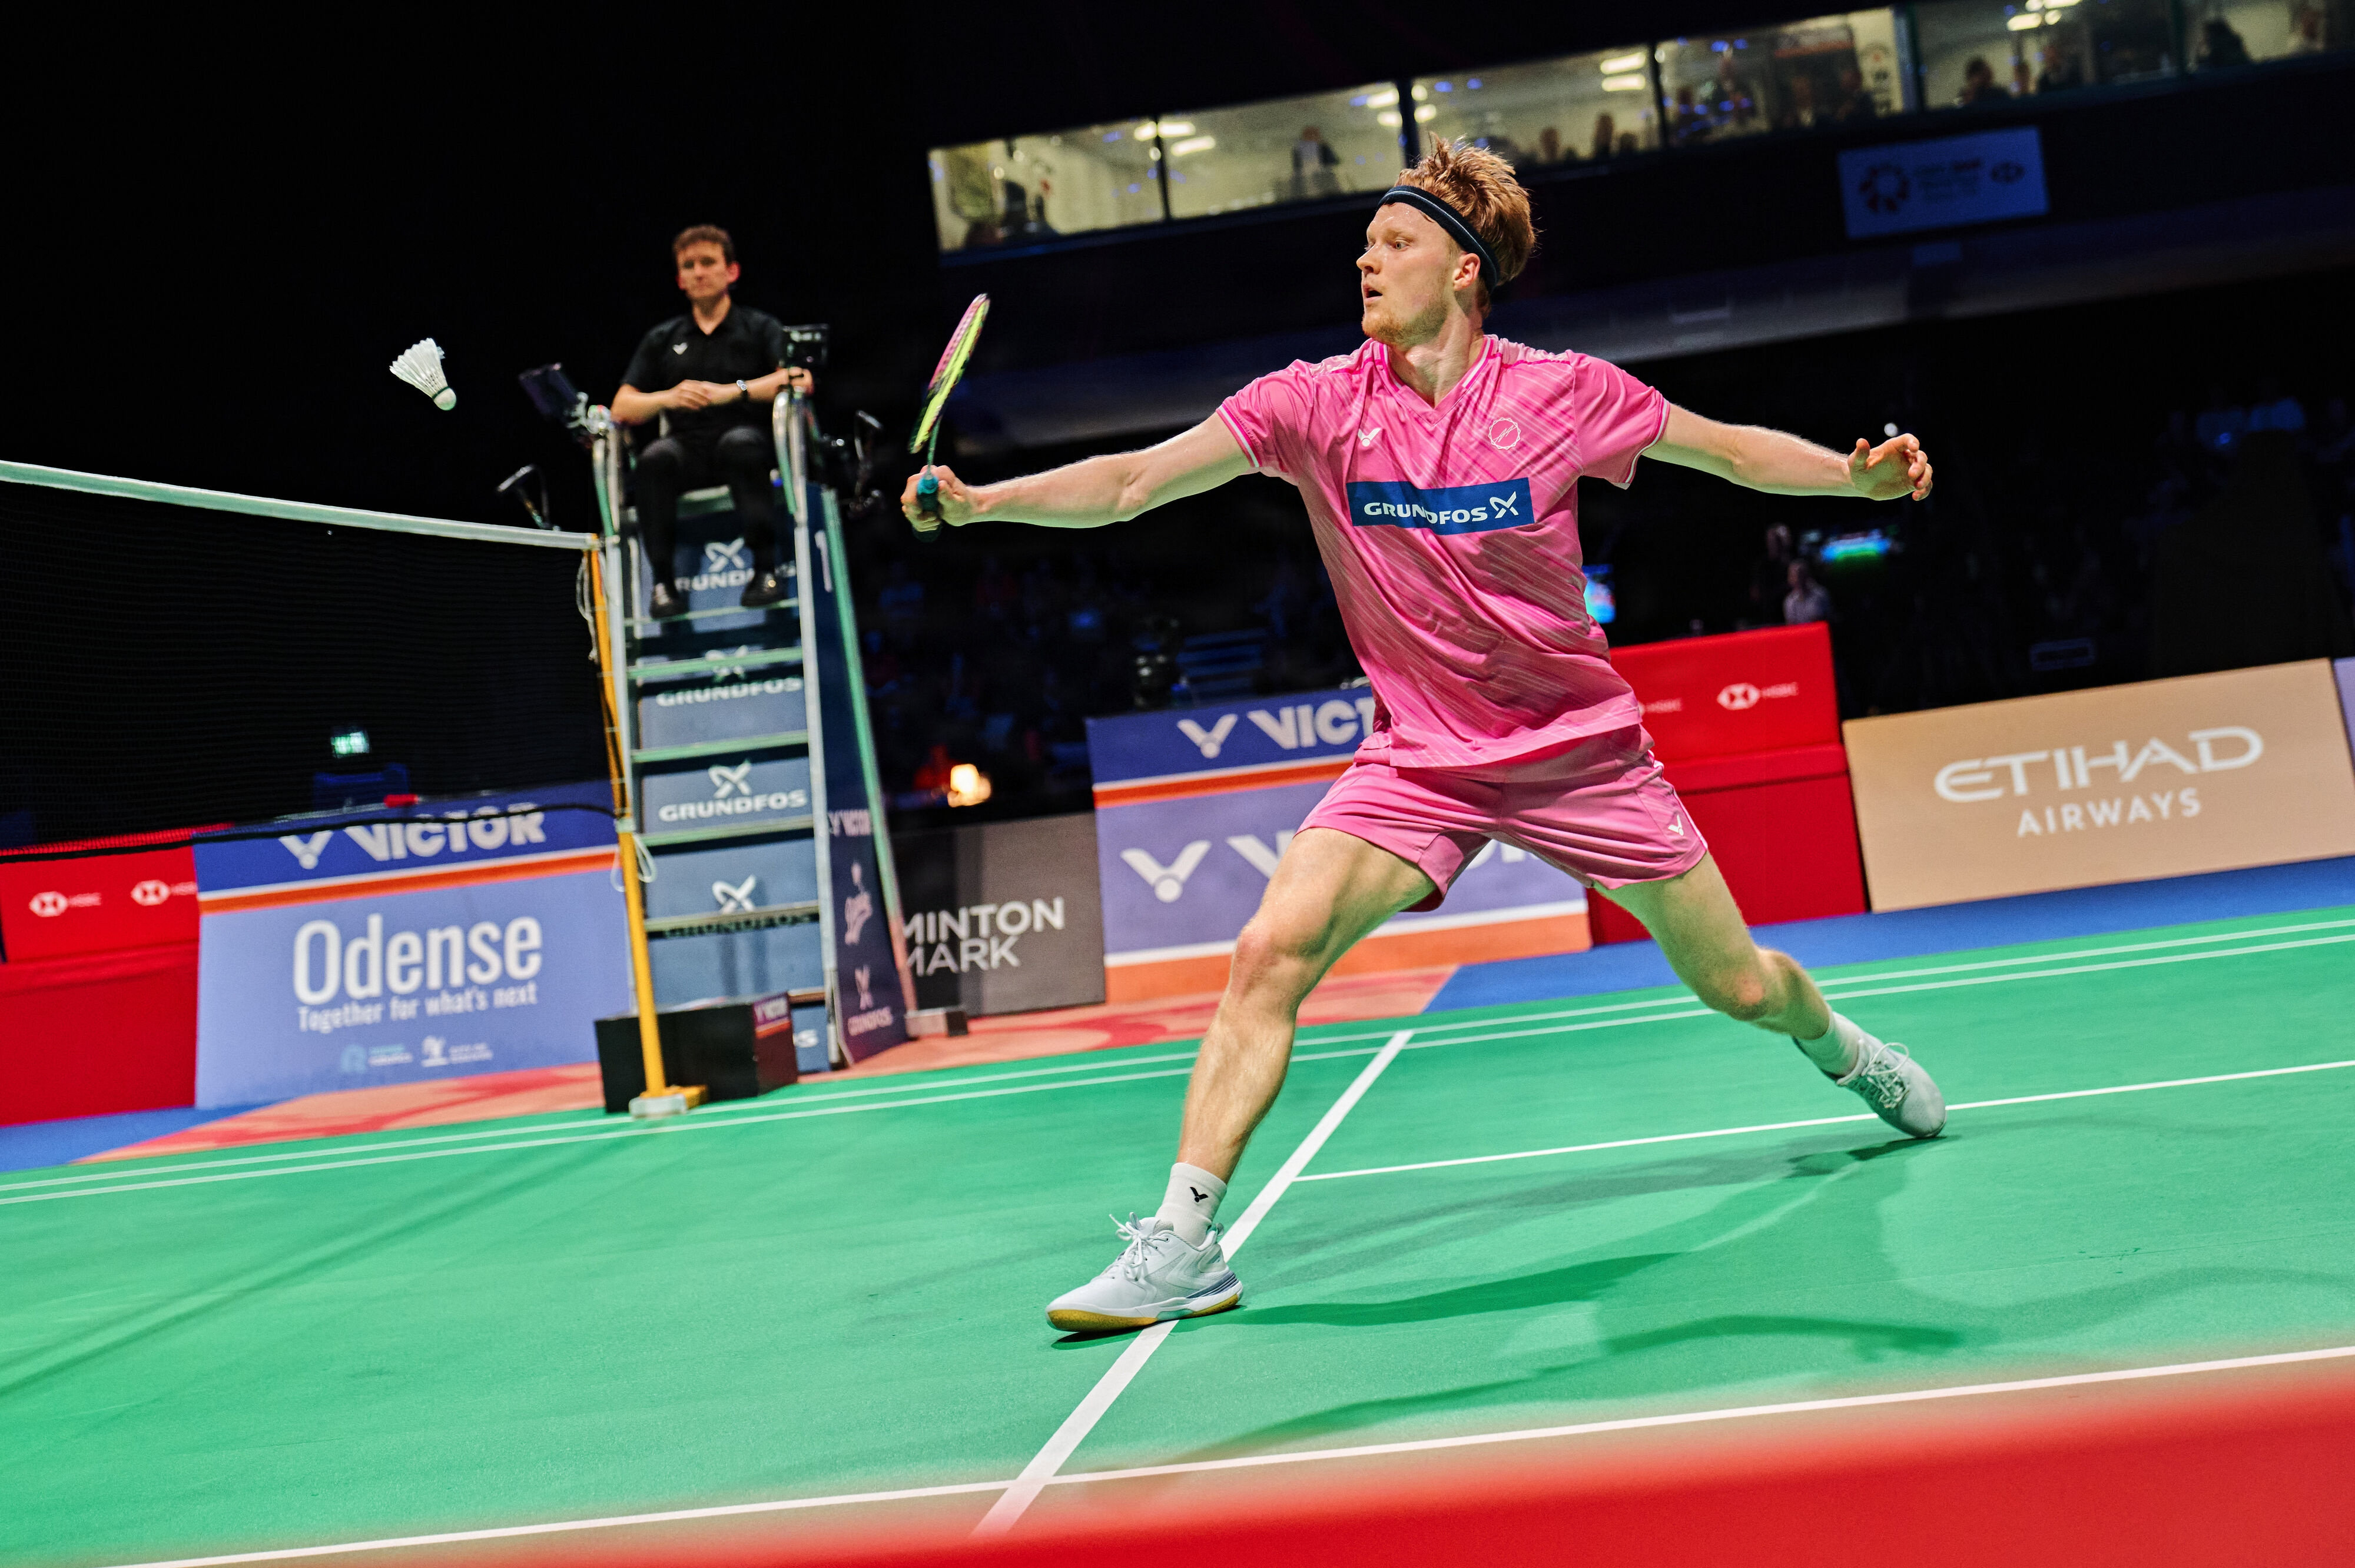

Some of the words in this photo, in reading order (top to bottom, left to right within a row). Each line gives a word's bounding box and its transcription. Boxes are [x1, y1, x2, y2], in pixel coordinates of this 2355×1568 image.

[1364, 502, 1488, 524] GRUNDFOS
[655, 676, 802, 706] GRUNDFOS
[1246, 696, 1376, 749] VICT
[1933, 725, 2264, 803] ETIHAD
[344, 802, 546, 861] VICTOR
[658, 789, 807, 822] GRUNDFOS
[2017, 787, 2201, 838] AIRWAYS
[294, 912, 543, 1005] Odense
[298, 1002, 383, 1034] Together
[390, 996, 419, 1021] for
[424, 986, 489, 1016] what's
[493, 979, 538, 1009] next
